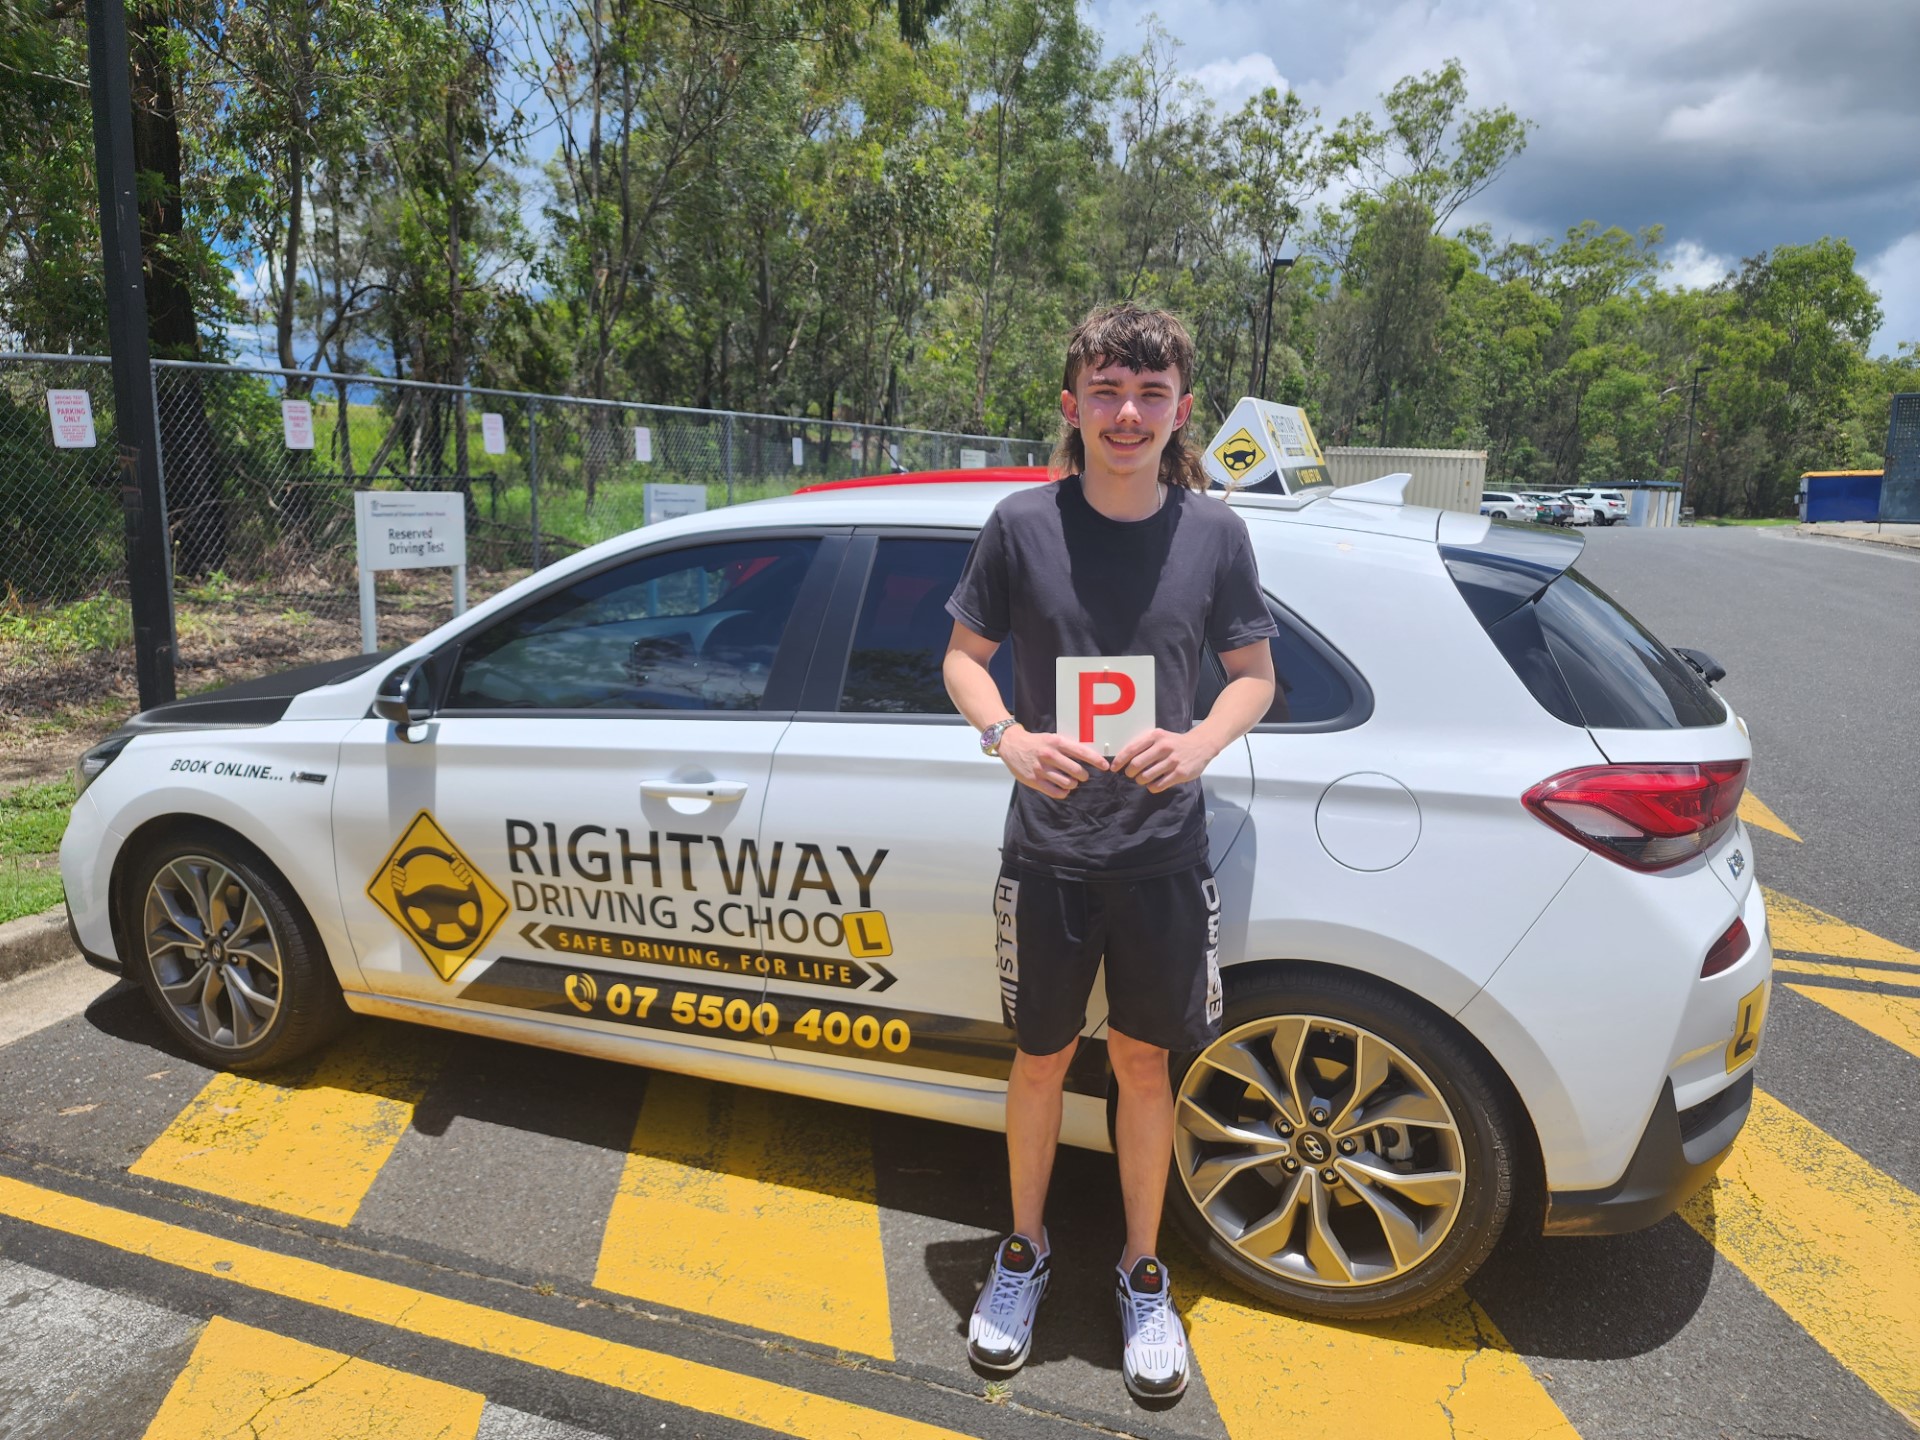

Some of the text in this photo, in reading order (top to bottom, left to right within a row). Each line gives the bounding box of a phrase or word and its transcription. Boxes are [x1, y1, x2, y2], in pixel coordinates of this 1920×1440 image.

[388, 526, 433, 540] Reserved
[389, 541, 445, 556] Driving Test
[1079, 671, 1136, 743] P
[170, 759, 212, 773] BOOK
[214, 762, 283, 781] ONLINE...
[505, 818, 890, 908] RIGHTWAY
[512, 880, 885, 952] DRIVING SCHOOL
[558, 932, 851, 983] SAFE DRIVING, FOR LIFE
[606, 983, 912, 1053] 07 5500 4000
